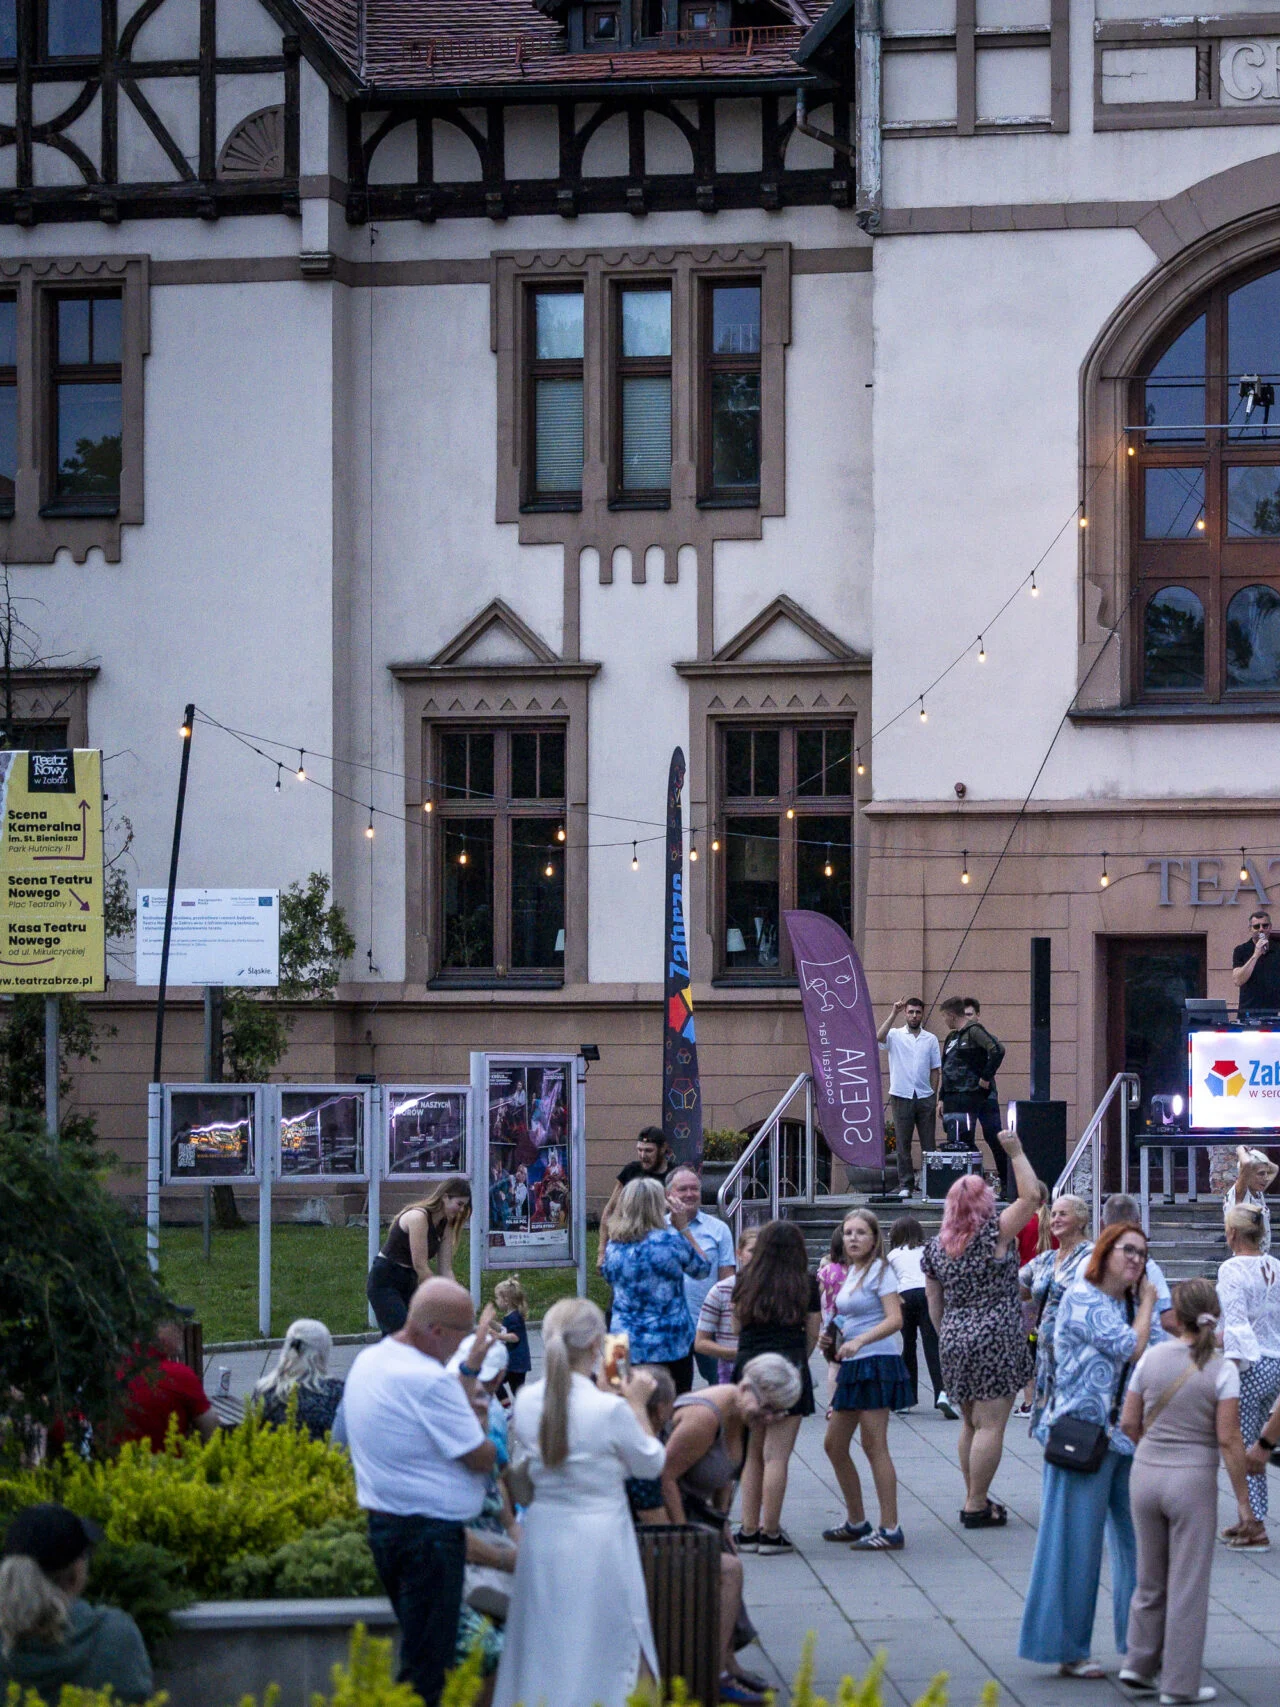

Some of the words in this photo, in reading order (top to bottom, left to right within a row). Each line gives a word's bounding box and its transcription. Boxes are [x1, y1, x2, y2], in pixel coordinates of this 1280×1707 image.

[32, 755, 68, 766] Teatr
[33, 765, 68, 778] Nowy
[8, 810, 47, 820] Scena
[8, 822, 81, 832] Kameralna
[8, 835, 22, 843] im.
[36, 834, 78, 842] Bieniasza
[8, 845, 27, 853] Park
[28, 845, 63, 853] Hutniczy
[8, 876, 47, 885] Scena
[49, 875, 93, 884] Teatru
[8, 888, 60, 900] Nowego
[8, 901, 26, 909] Plac
[28, 901, 67, 909] Teatralny
[8, 924, 41, 933] Kasa
[44, 923, 87, 932] Teatru
[8, 936, 61, 948] Nowego
[33, 948, 86, 957] Mikulczyckiej
